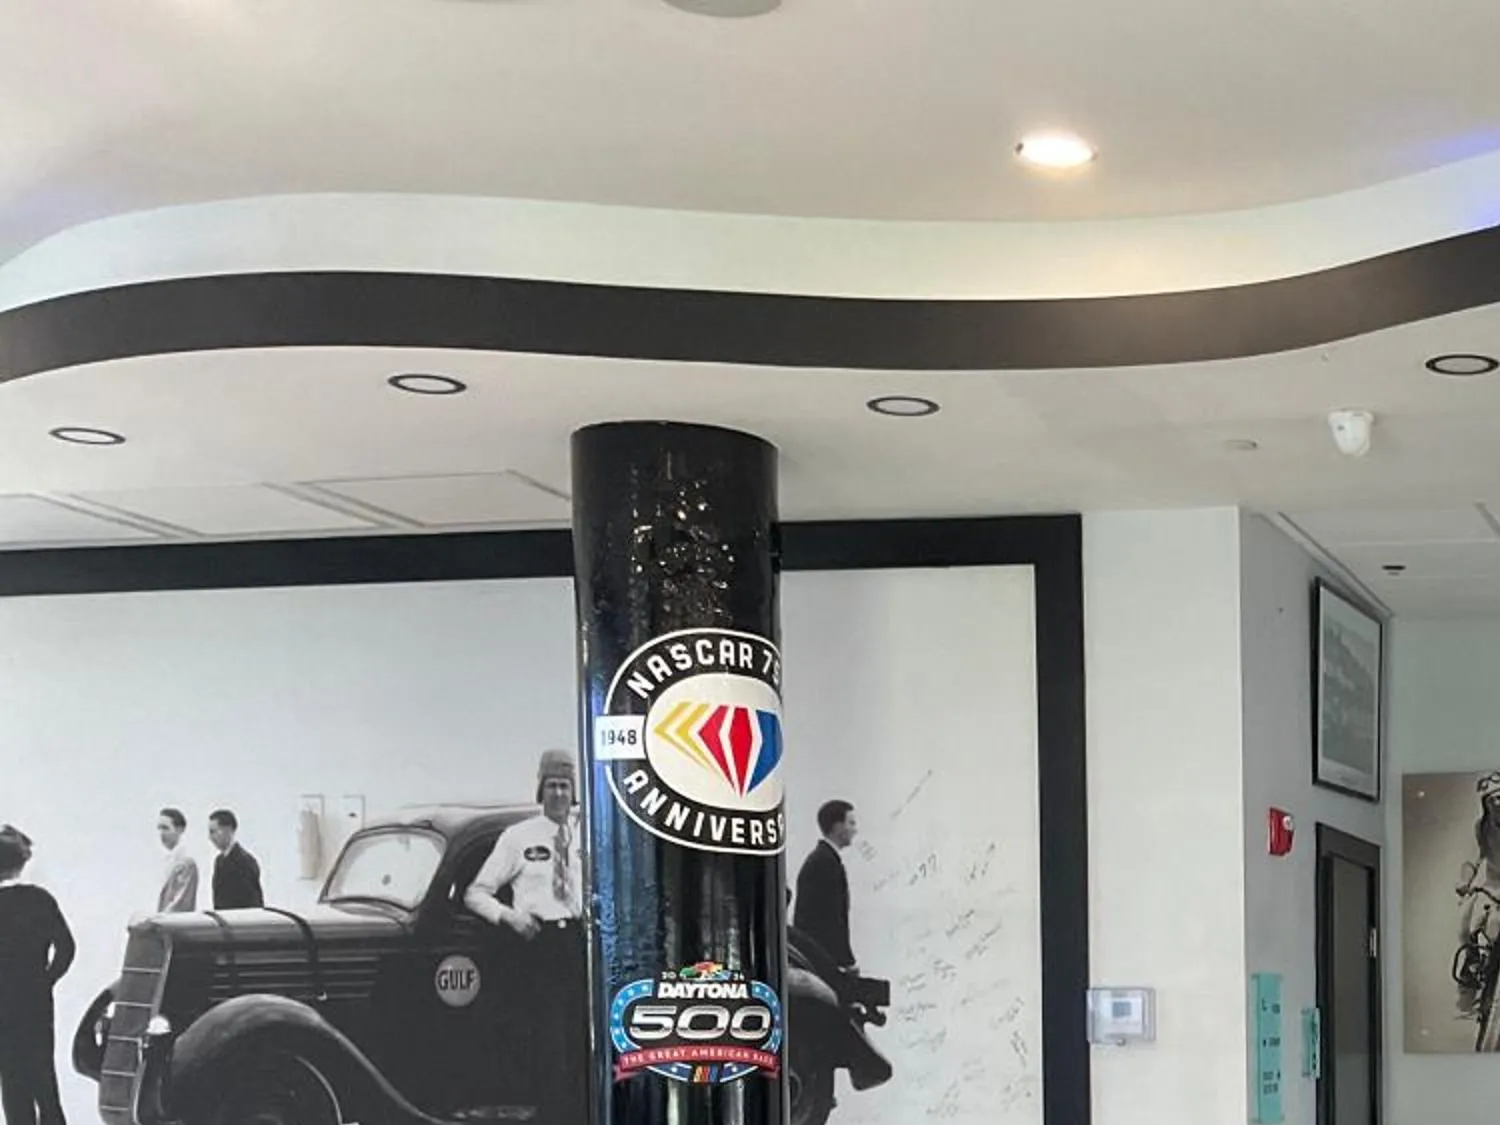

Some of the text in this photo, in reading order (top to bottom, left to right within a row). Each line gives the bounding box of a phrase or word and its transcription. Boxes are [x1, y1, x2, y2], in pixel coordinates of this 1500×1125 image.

[626, 639, 754, 699] NASCAR
[601, 729, 638, 746] 1948
[437, 968, 476, 991] GULF
[657, 982, 749, 999] DAYTONA
[629, 1005, 771, 1040] 500
